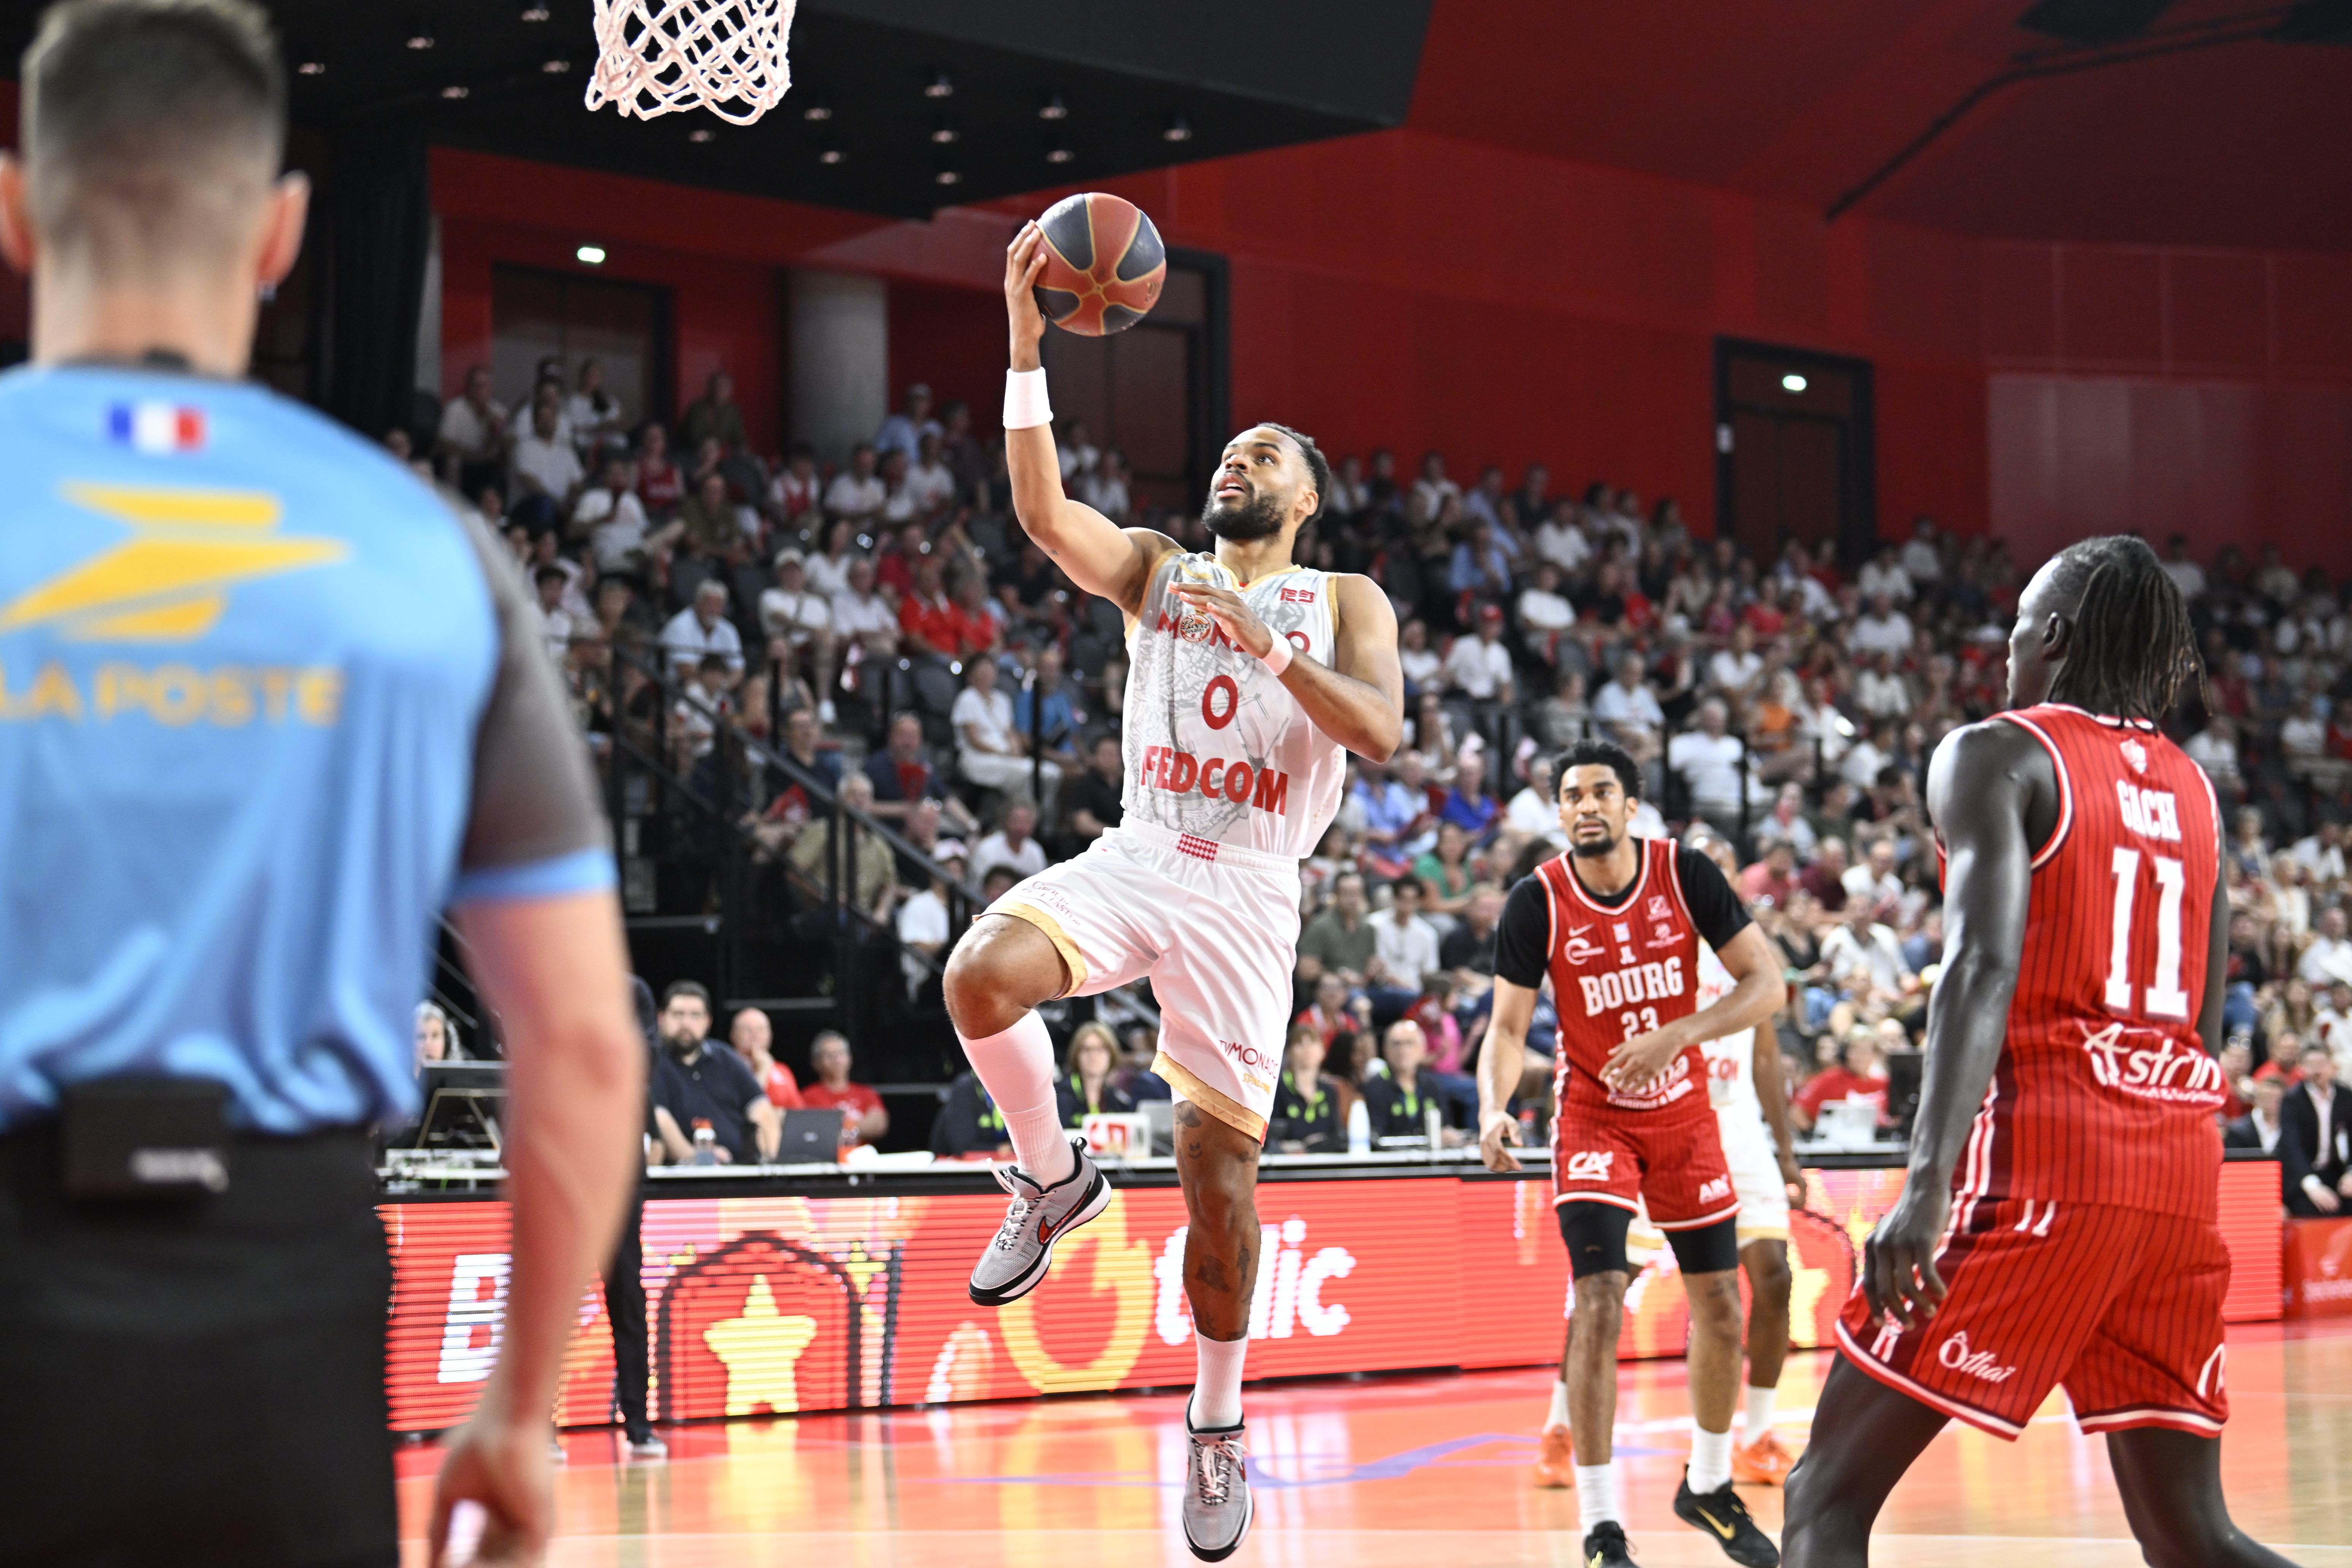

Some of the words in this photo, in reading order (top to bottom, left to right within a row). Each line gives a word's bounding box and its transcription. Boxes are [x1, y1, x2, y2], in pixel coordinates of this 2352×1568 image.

[92, 661, 340, 729] POSTE
[1141, 745, 1288, 816] FEDCOM
[2116, 779, 2181, 841] GACH
[2104, 845, 2189, 1023] 11
[1578, 955, 1684, 1017] BOURG
[1620, 1006, 1659, 1042] 23
